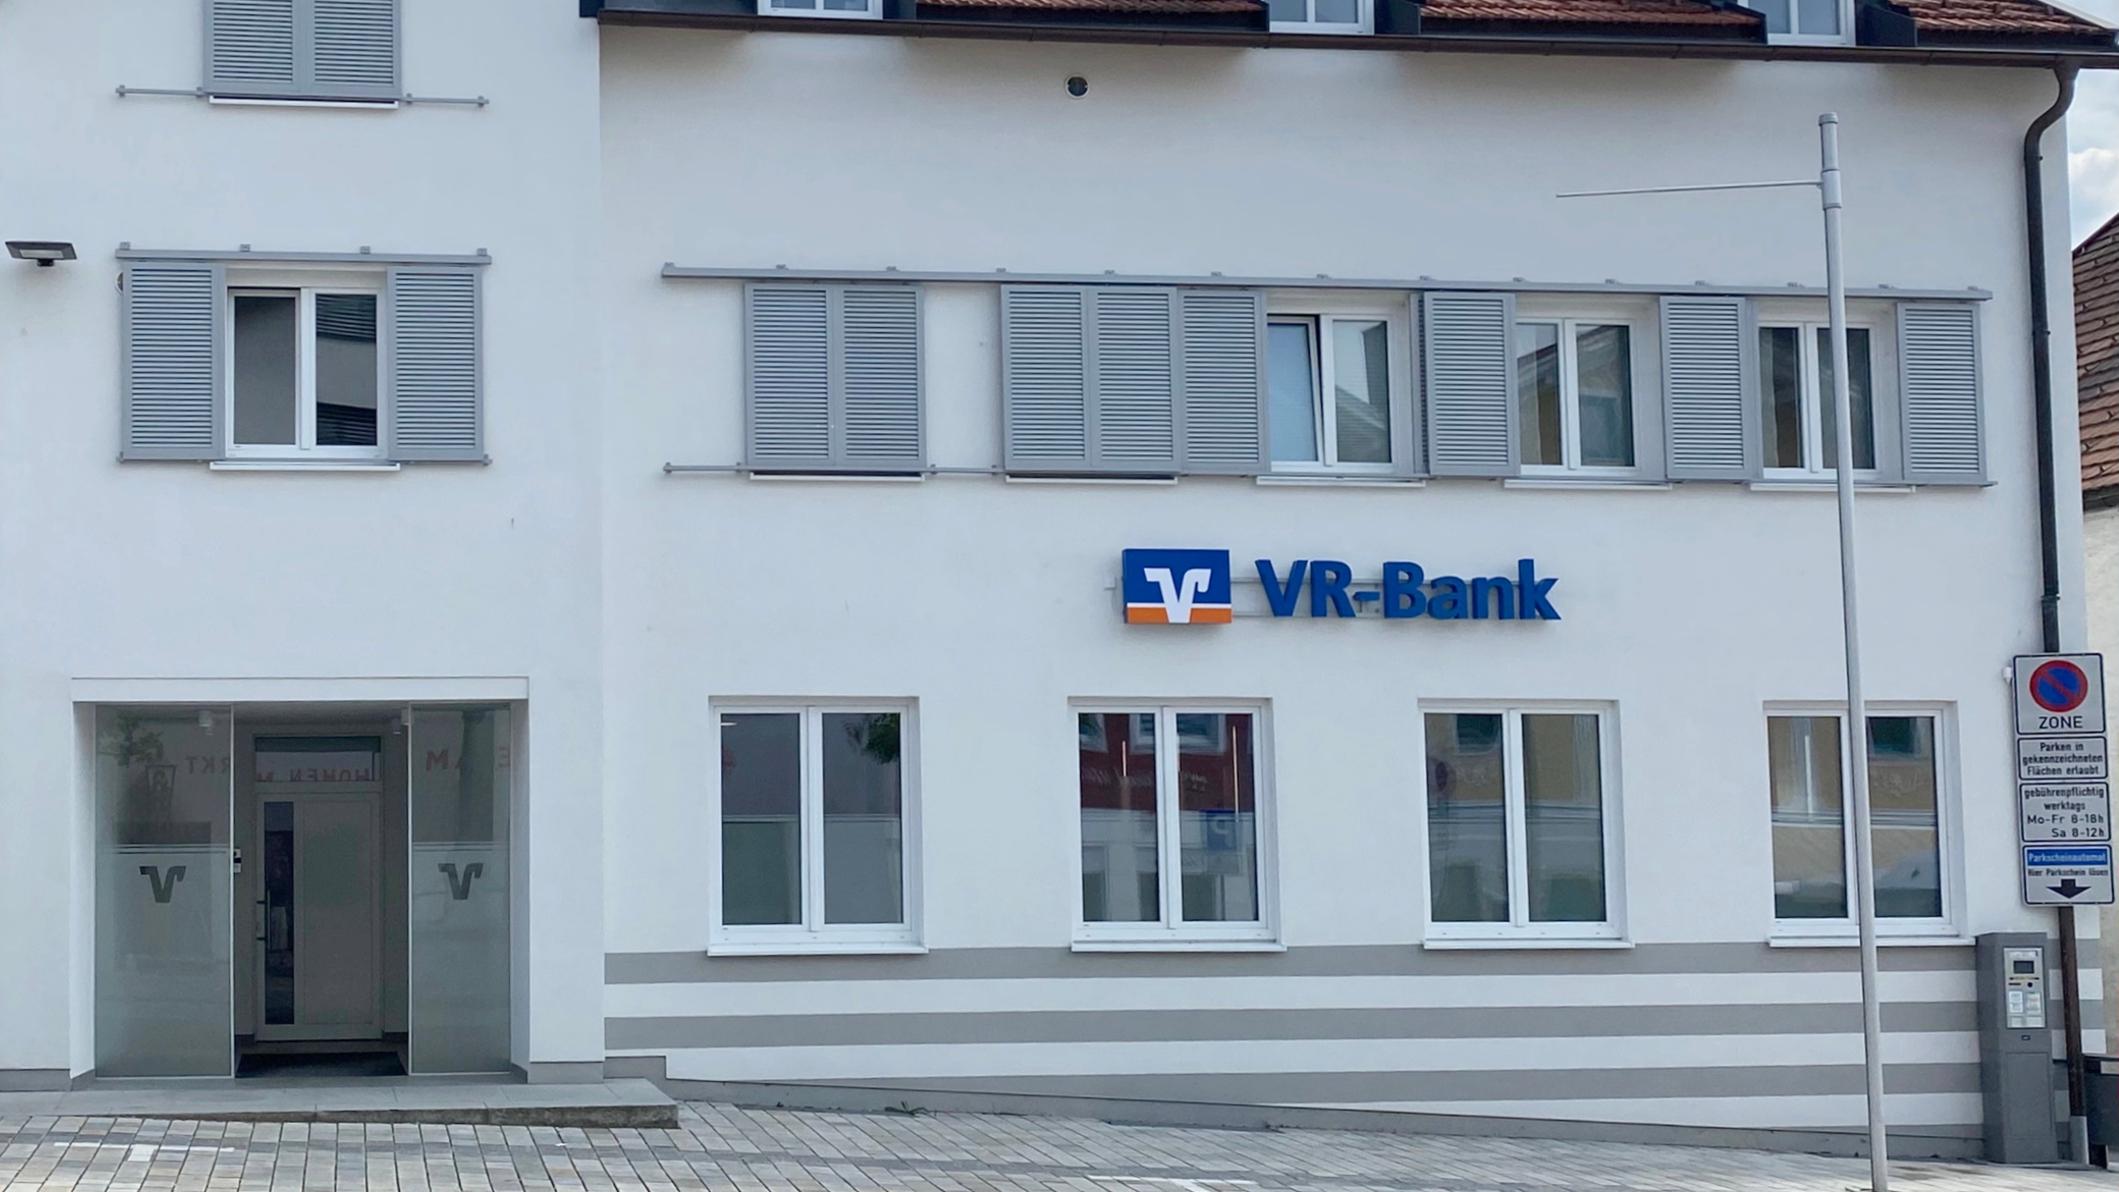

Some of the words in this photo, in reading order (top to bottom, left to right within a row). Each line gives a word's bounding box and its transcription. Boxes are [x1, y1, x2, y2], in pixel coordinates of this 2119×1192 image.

[1254, 558, 1562, 621] VR-Bank
[2038, 715, 2083, 729] ZONE
[2040, 742, 2072, 752] Parken
[2075, 742, 2084, 751] in
[2022, 753, 2103, 766] gekennzeichneten
[2027, 765, 2062, 776] Flächen
[2066, 764, 2099, 775] erlaubt
[2024, 786, 2104, 799] gebührenpflichtig
[2044, 800, 2086, 812] werktags
[2027, 814, 2065, 824] Mo-Fr
[2051, 828, 2067, 838] Sa
